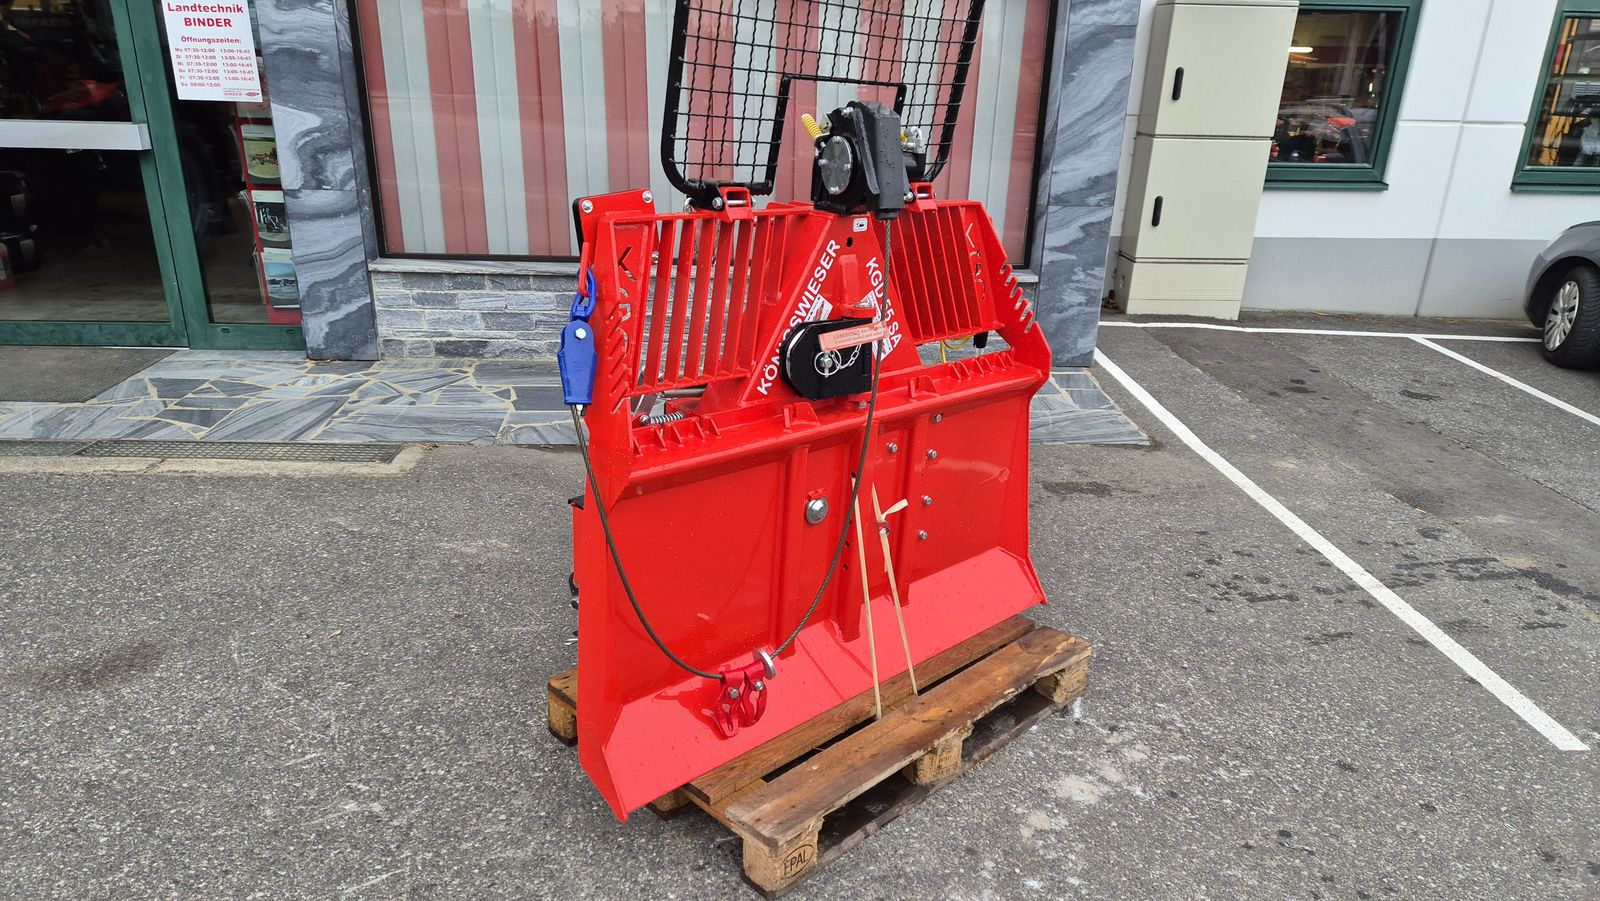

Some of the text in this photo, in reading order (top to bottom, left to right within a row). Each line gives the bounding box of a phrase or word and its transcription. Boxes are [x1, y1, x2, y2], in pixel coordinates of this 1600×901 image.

[167, 2, 244, 13] Landtechnik
[184, 17, 233, 27] BINDER
[180, 35, 242, 44] Öffnungszeiten:
[888, 321, 902, 348] SA
[783, 850, 809, 876] EPAL
